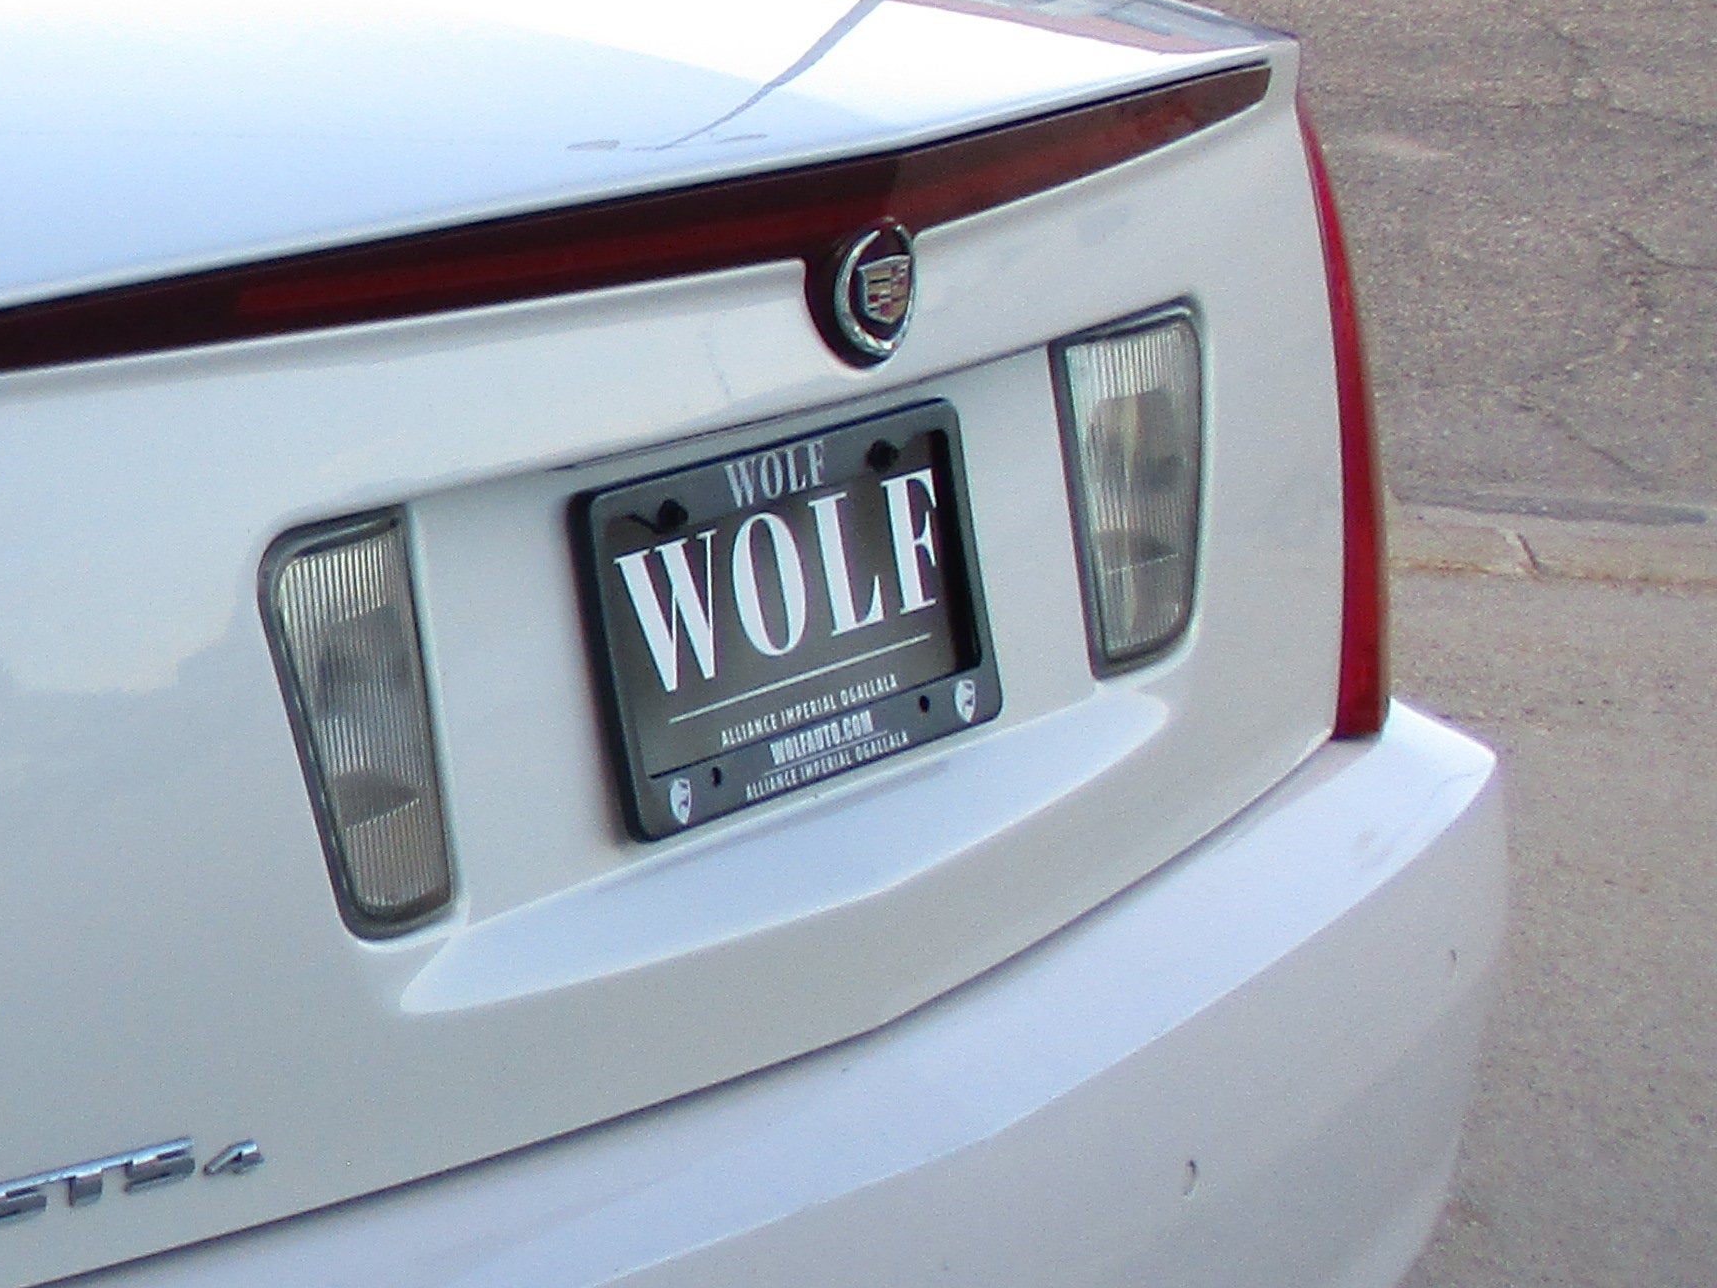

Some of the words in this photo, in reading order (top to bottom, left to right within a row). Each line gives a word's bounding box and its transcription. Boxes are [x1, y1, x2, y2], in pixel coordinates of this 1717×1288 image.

[724, 440, 825, 508] WOLF
[613, 468, 939, 694] WOLF
[721, 713, 778, 748] ALLIANCE
[781, 693, 837, 727] IMPERIAL
[839, 673, 898, 707] OGALLALA
[769, 709, 874, 766] WOLFAUTO.COM
[746, 768, 797, 801] ALLIANCE
[799, 751, 852, 779] IMPERIAL
[854, 730, 910, 762] OGALLALA
